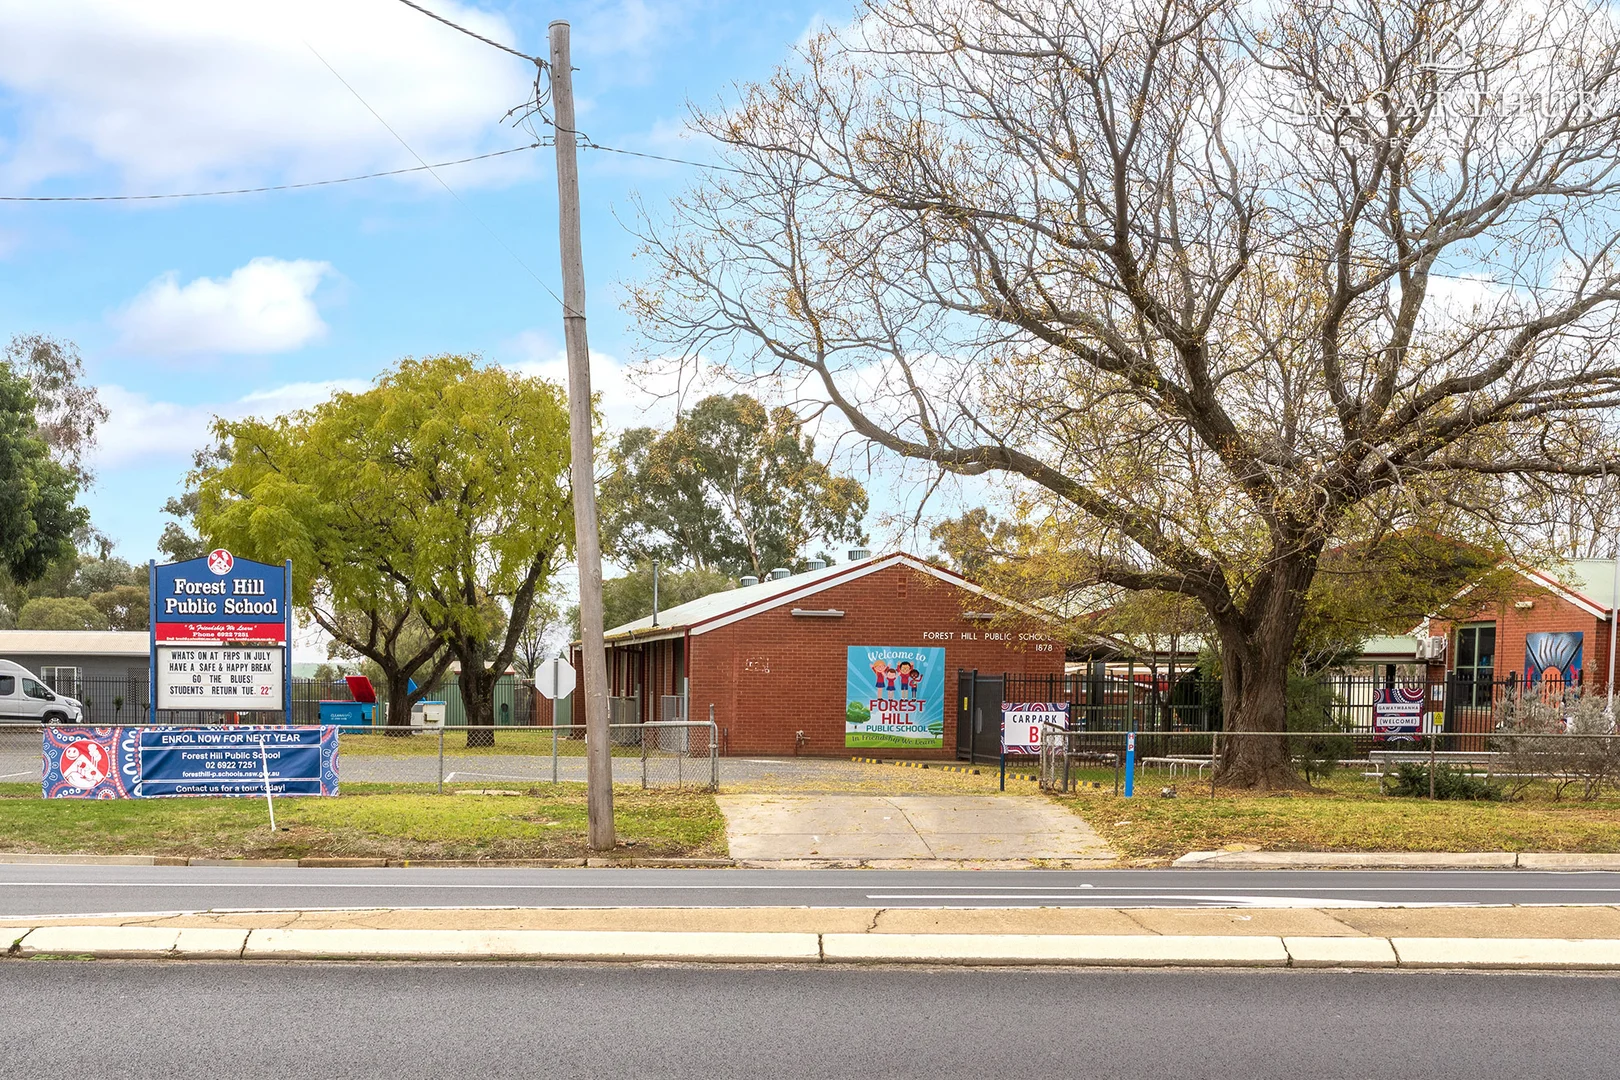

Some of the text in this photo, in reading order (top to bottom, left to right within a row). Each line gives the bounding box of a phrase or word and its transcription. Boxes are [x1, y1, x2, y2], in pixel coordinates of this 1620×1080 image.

[174, 579, 265, 595] Forest Hill
[165, 598, 278, 614] Public School
[196, 624, 224, 632] Friendship
[923, 632, 954, 640] FOREST
[1018, 632, 1052, 641] SCHOOL
[172, 652, 270, 660] WHATS ON AT FHPS IN JULY
[868, 649, 926, 662] Welcome to
[170, 663, 272, 672] HAVE A SAFE & HAPPY BREAK
[192, 675, 253, 684] GO THE BLUES!
[170, 686, 204, 695] STUDENTS
[212, 686, 237, 695] RETURN
[242, 686, 256, 695] TUE.
[870, 700, 926, 712] FOREST
[882, 713, 913, 724] HILL
[1012, 714, 1057, 724] CARPARK
[162, 734, 300, 744] ENROL NOW FOR NEXT YEAR
[1029, 726, 1040, 743] B
[862, 735, 900, 744] Friendship
[225, 752, 250, 760] Public
[252, 751, 280, 760] School
[176, 785, 207, 793] Contact
[260, 784, 286, 792] today!
